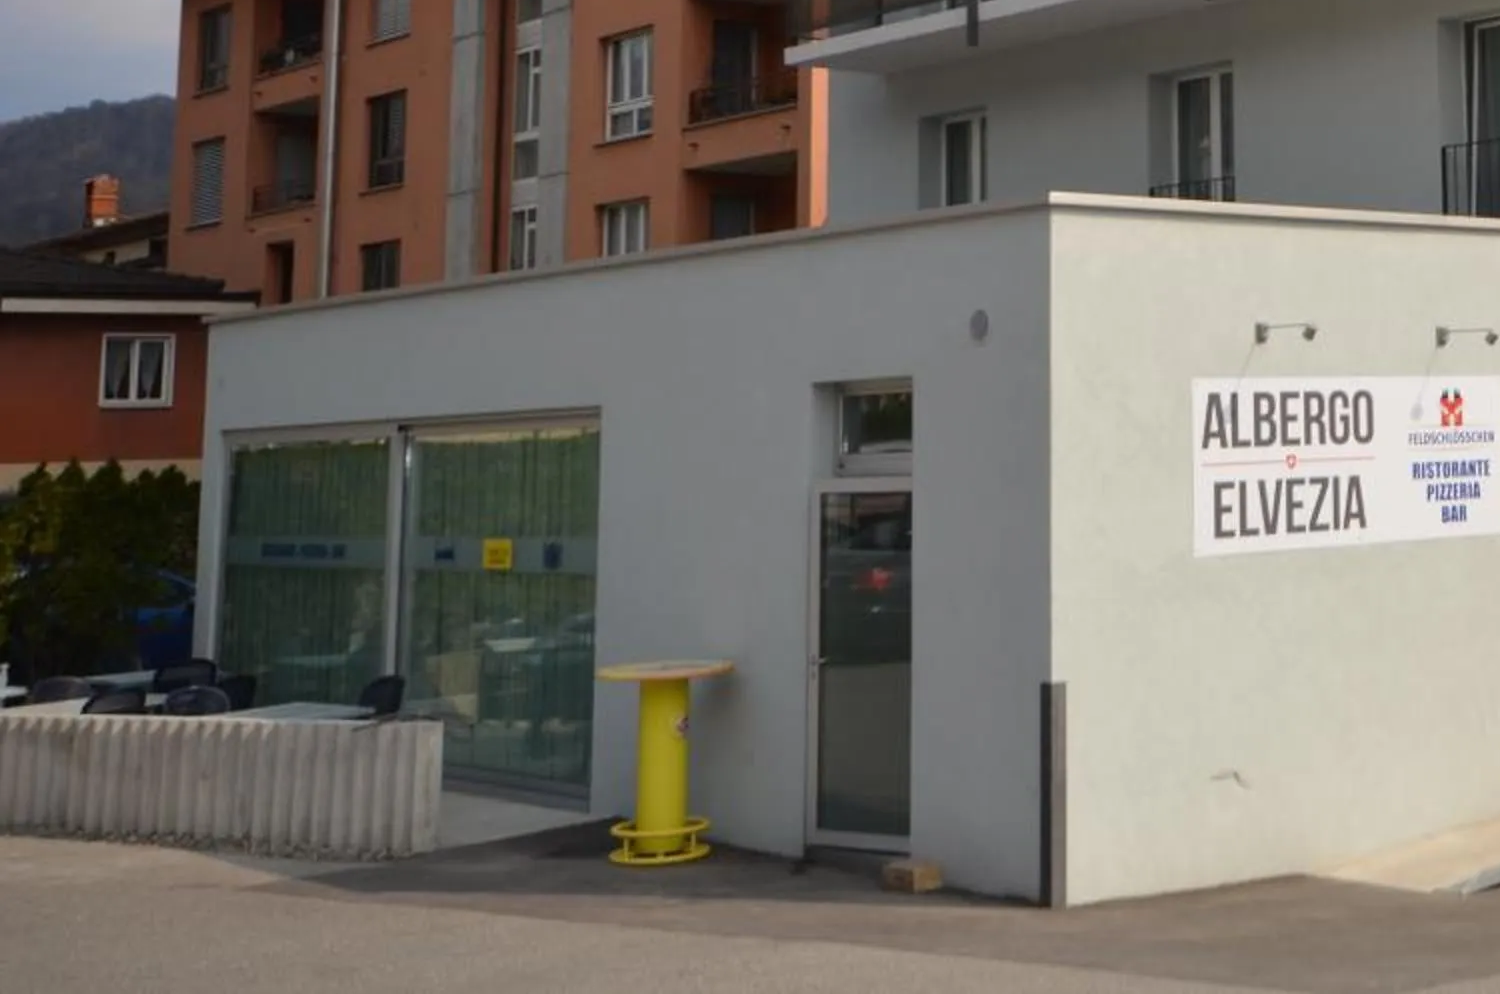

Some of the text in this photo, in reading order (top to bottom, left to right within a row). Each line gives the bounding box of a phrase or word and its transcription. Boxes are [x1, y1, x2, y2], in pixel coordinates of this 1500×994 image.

[1201, 390, 1375, 450] ALBERGO
[1412, 459, 1491, 480] RISTORANTE
[1426, 482, 1481, 501] PIZZERIA
[1213, 475, 1367, 539] ELVEZIA
[1441, 504, 1467, 523] BAR
